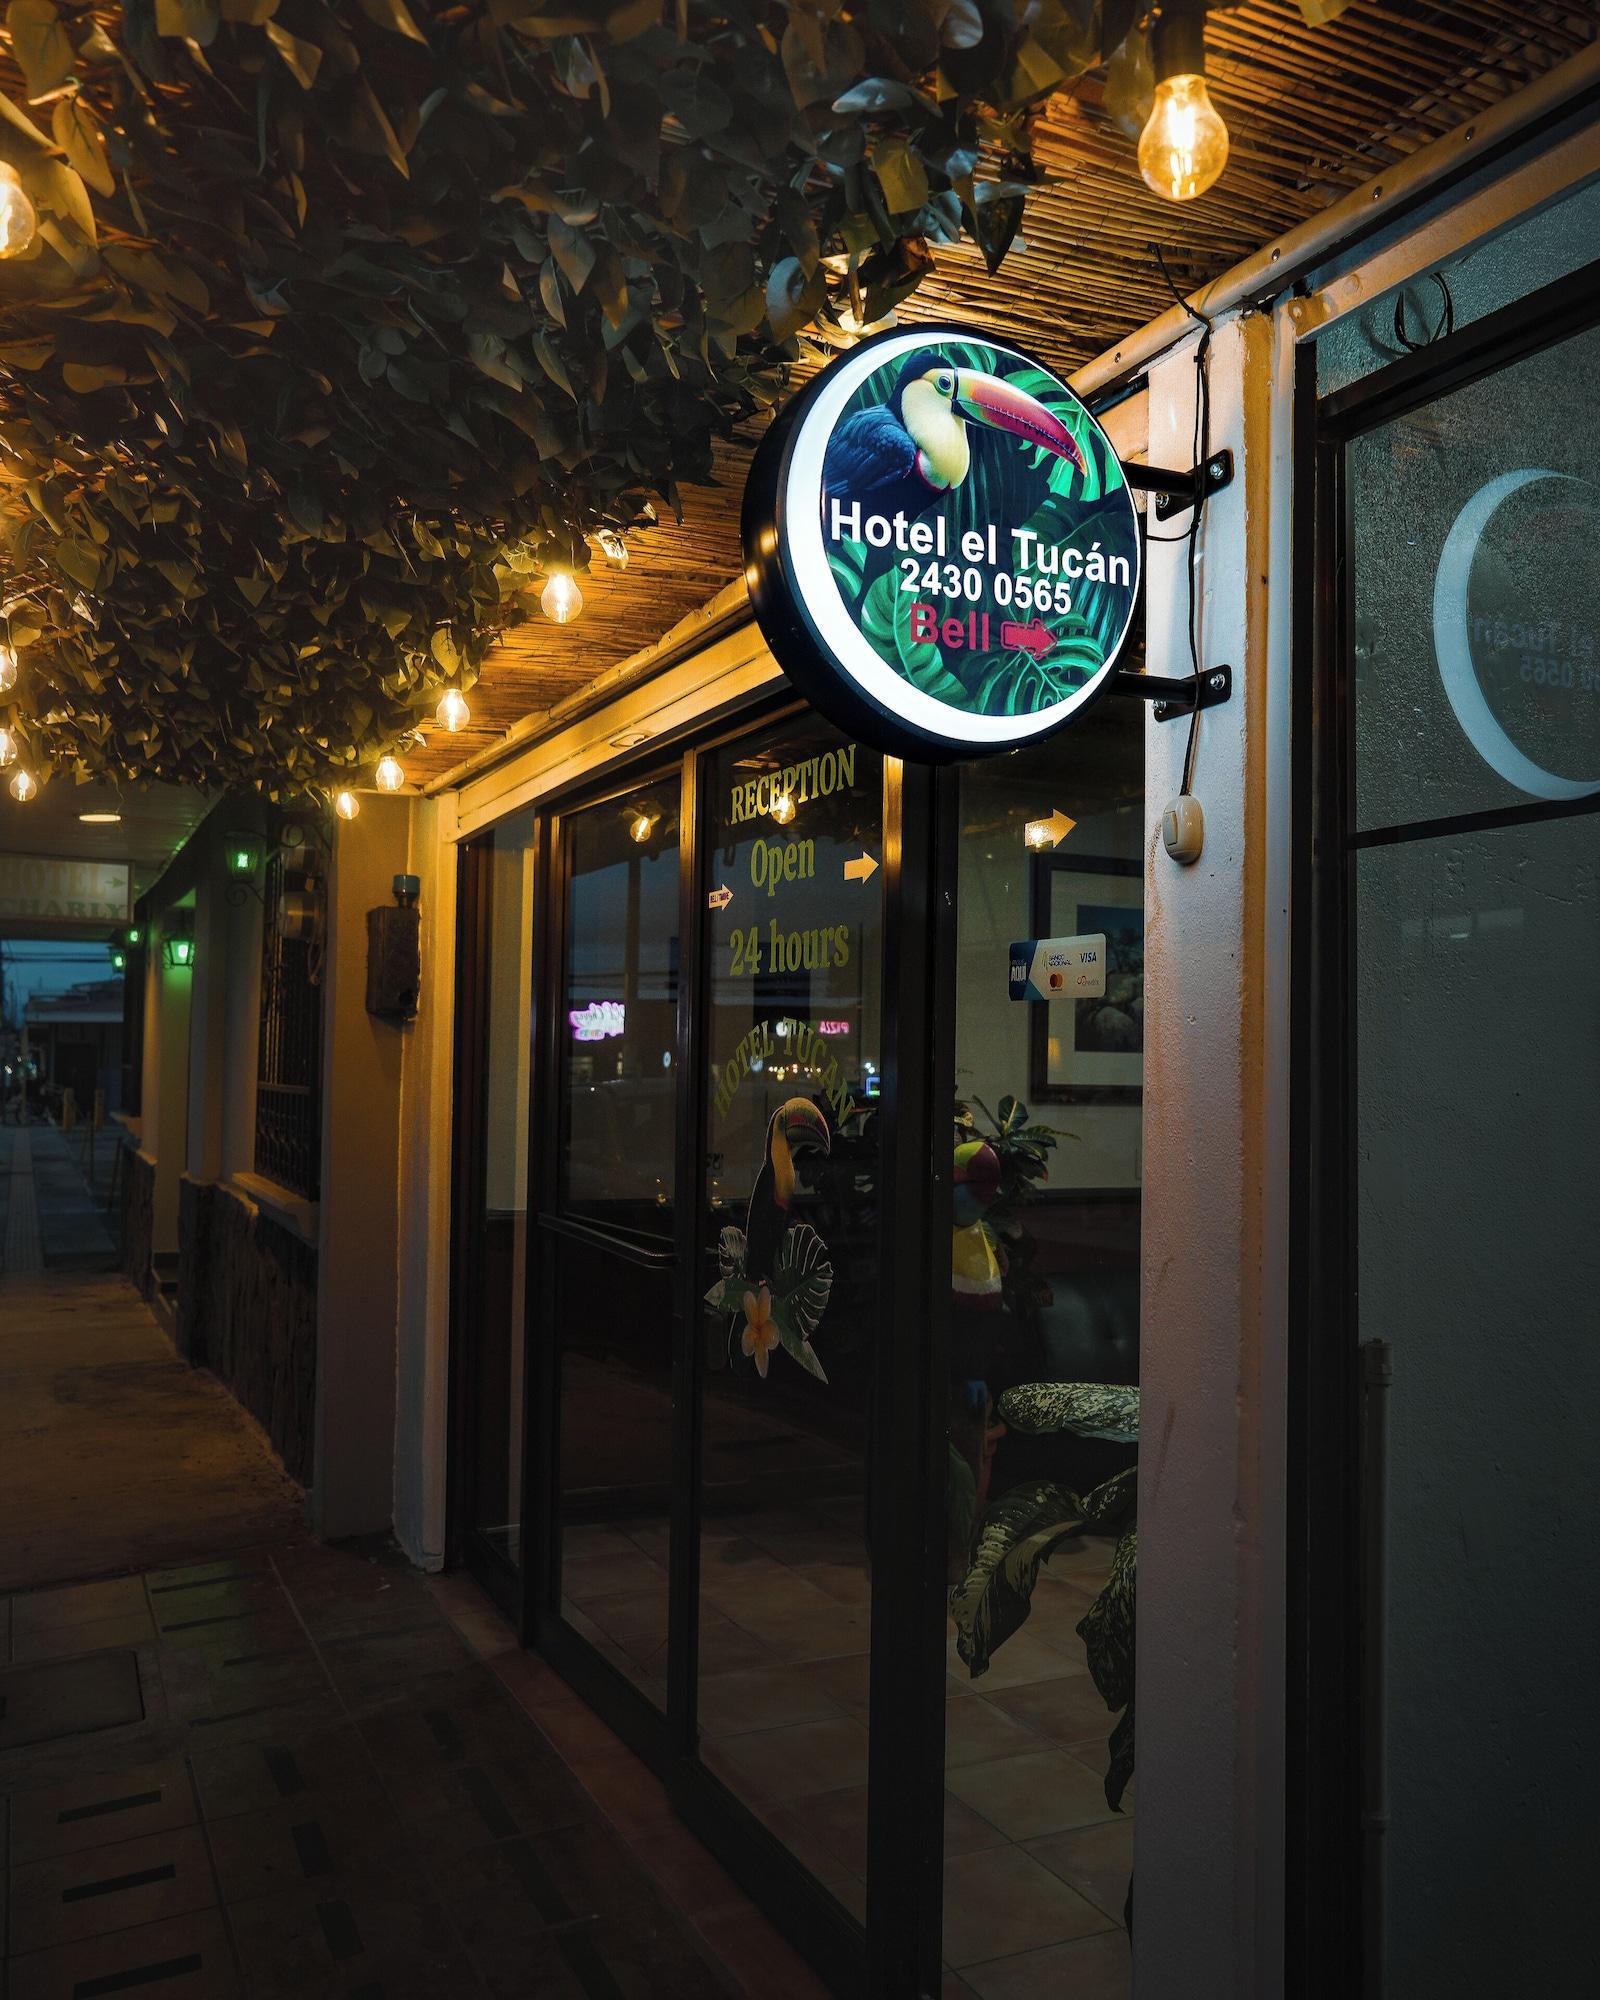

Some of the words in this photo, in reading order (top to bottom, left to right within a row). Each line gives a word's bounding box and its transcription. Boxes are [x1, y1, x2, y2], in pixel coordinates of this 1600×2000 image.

[831, 498, 946, 557] Hotel
[961, 524, 997, 565] el
[1011, 528, 1130, 587] Tucán
[900, 557, 983, 602] 2430
[994, 573, 1072, 615] 0565
[910, 602, 989, 652] Bell
[730, 743, 857, 825] RECEPTION
[0, 858, 105, 897] HOTEL
[751, 838, 815, 897] Open
[729, 926, 762, 976] 24
[768, 918, 849, 974] hours
[1080, 951, 1097, 963] VISA
[714, 1020, 775, 1120] HOTEL
